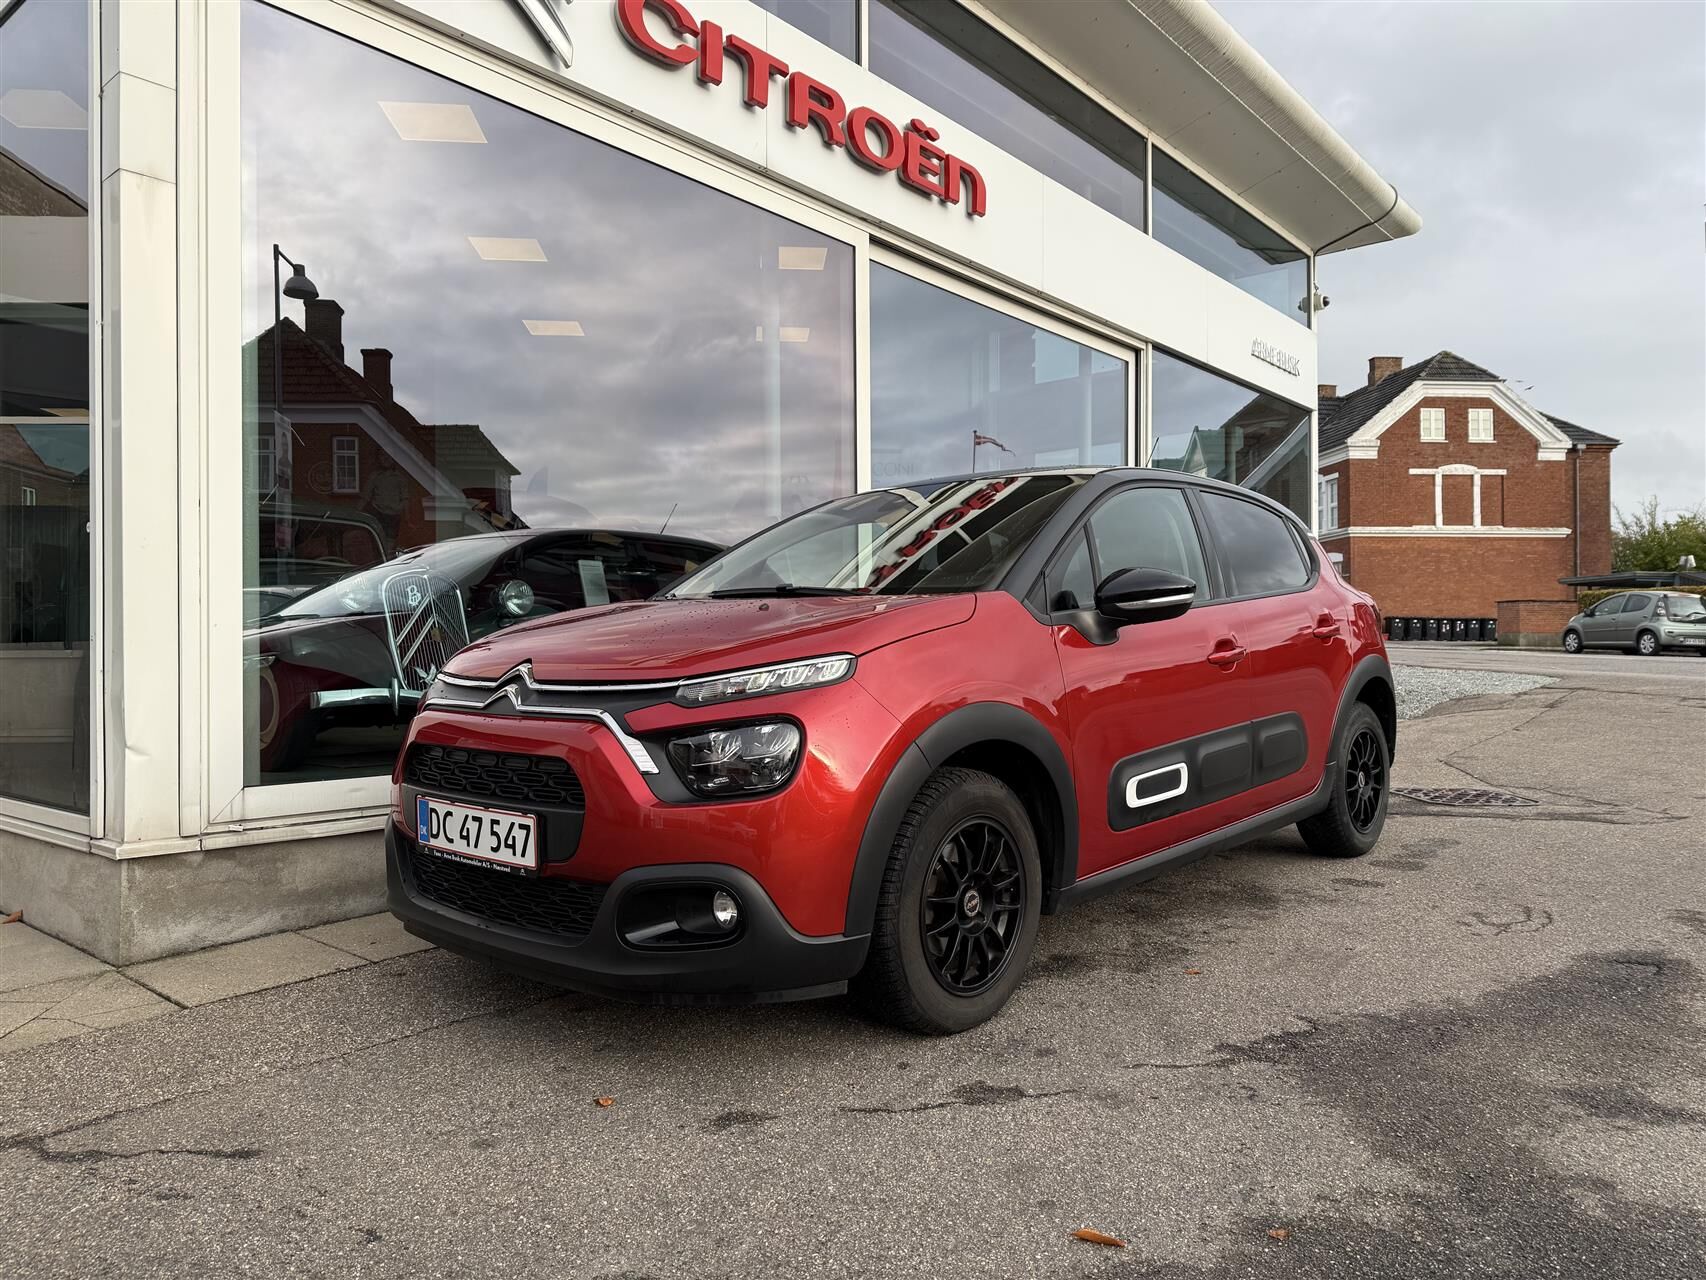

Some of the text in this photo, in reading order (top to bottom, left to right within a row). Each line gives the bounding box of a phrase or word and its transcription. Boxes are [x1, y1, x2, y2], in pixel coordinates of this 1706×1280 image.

[614, 0, 987, 217] CITROËN
[429, 807, 531, 858] DC 47 547
